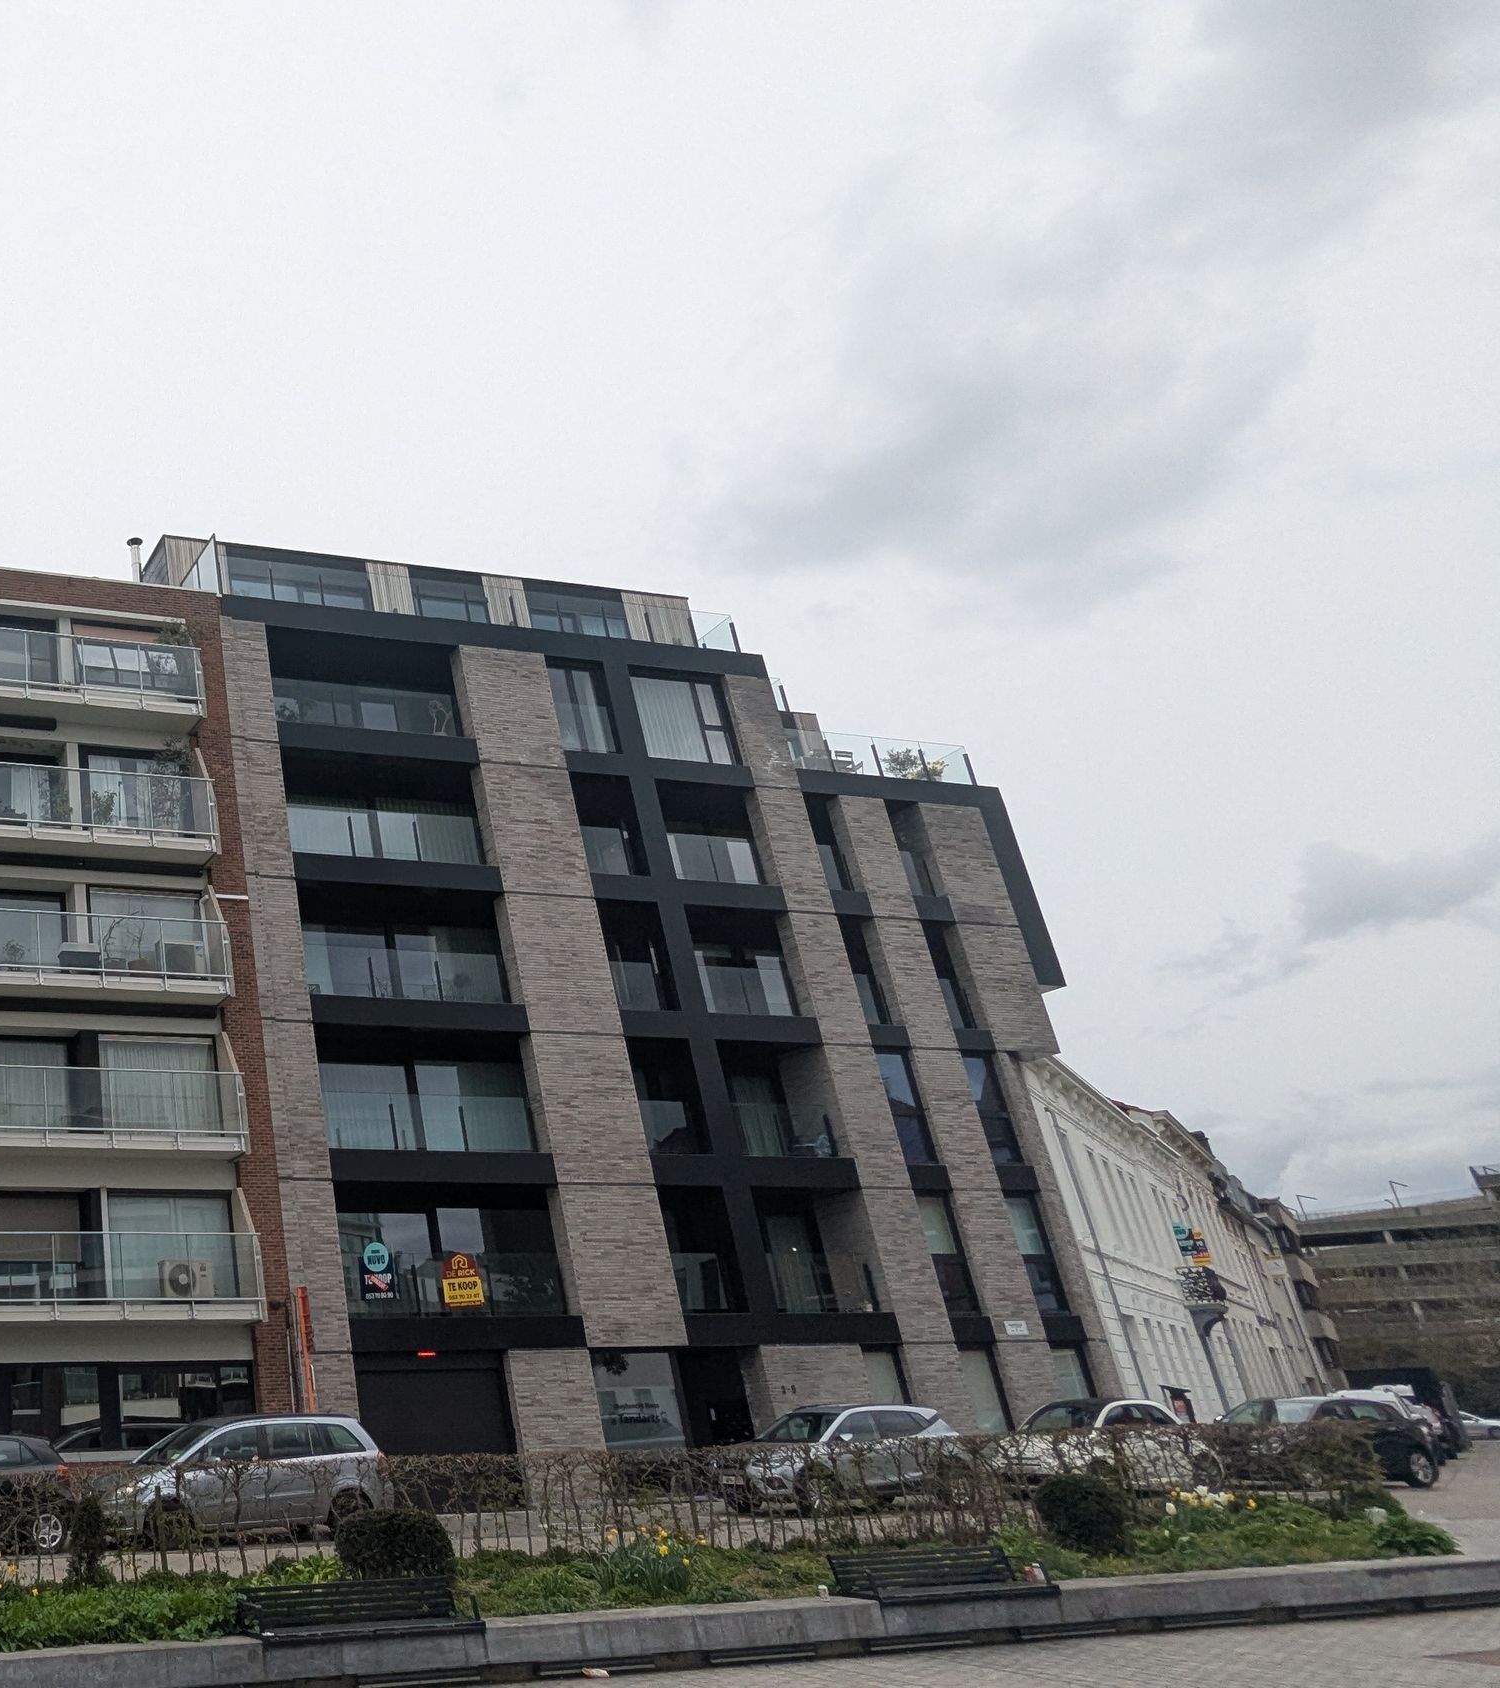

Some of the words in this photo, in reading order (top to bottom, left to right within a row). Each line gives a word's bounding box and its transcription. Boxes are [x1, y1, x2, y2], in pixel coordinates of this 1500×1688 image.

[367, 1255, 385, 1265] NUVO
[448, 1282, 456, 1291] TE
[458, 1281, 477, 1290] KOOP
